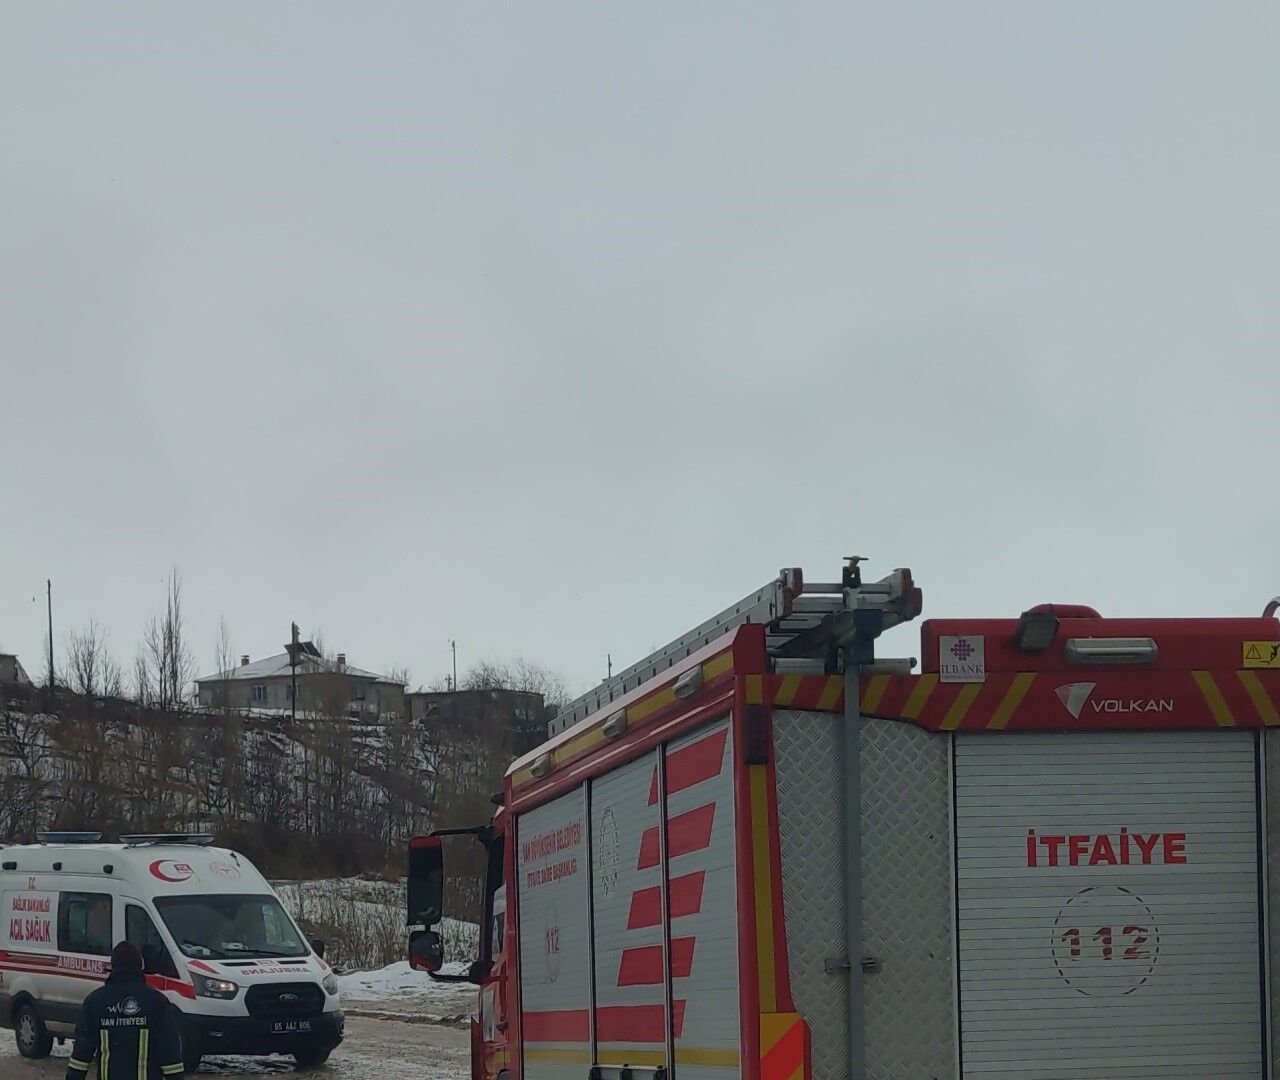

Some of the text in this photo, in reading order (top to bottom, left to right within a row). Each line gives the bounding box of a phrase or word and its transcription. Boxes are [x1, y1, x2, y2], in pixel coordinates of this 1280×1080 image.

[1091, 699, 1173, 713] VOLKAN
[1026, 827, 1187, 867] İTFAİYE
[26, 916, 51, 942] SAĞLIK
[1060, 926, 1150, 960] 112
[57, 956, 103, 973] AMBULANS
[100, 1018, 115, 1026] VAN
